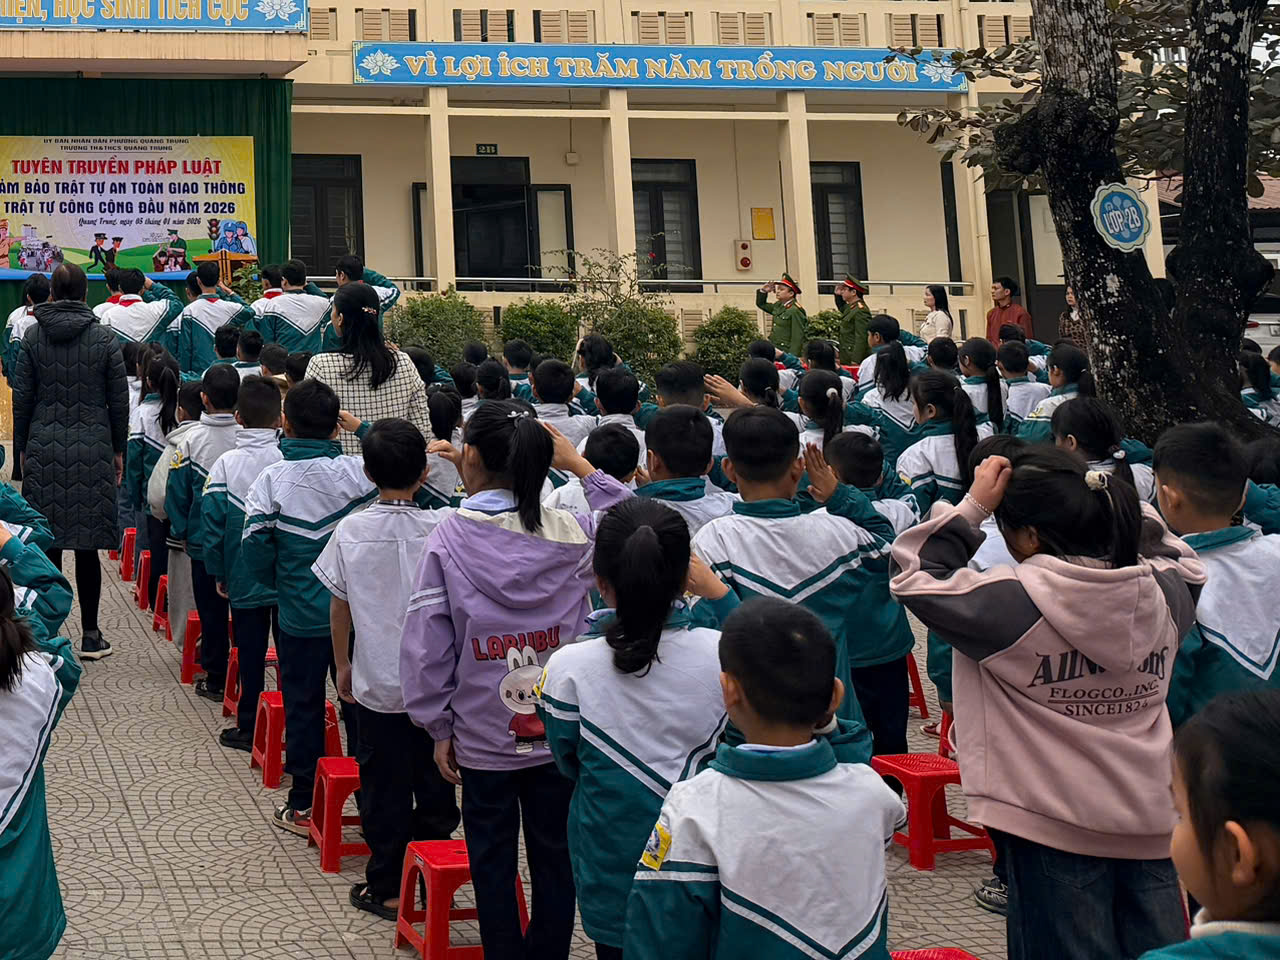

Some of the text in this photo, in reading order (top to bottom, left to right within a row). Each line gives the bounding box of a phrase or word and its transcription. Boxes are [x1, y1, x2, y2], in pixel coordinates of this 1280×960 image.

[403, 51, 438, 77] VÌ
[443, 54, 492, 80] LỢI
[497, 51, 549, 77] ÍCH
[554, 52, 640, 79] TRĂM
[644, 54, 712, 80] NĂM
[717, 51, 817, 80] TRỒNG
[11, 155, 222, 177] TUYÊN TRUYỀN PHÁP LUẬT
[24, 178, 50, 194] BẢO
[54, 180, 85, 196] TRẬT
[89, 181, 106, 196] TỰ
[109, 182, 126, 194] AN
[131, 180, 164, 194] TOÀN
[168, 182, 199, 194] GIAO
[203, 180, 246, 194] THÔNG
[4, 197, 236, 216] TRẬT TỰ CÔNG CỘNG ĐẦU NĂM 2026
[1124, 206, 1141, 229] 2B
[471, 625, 560, 661] LABUBU
